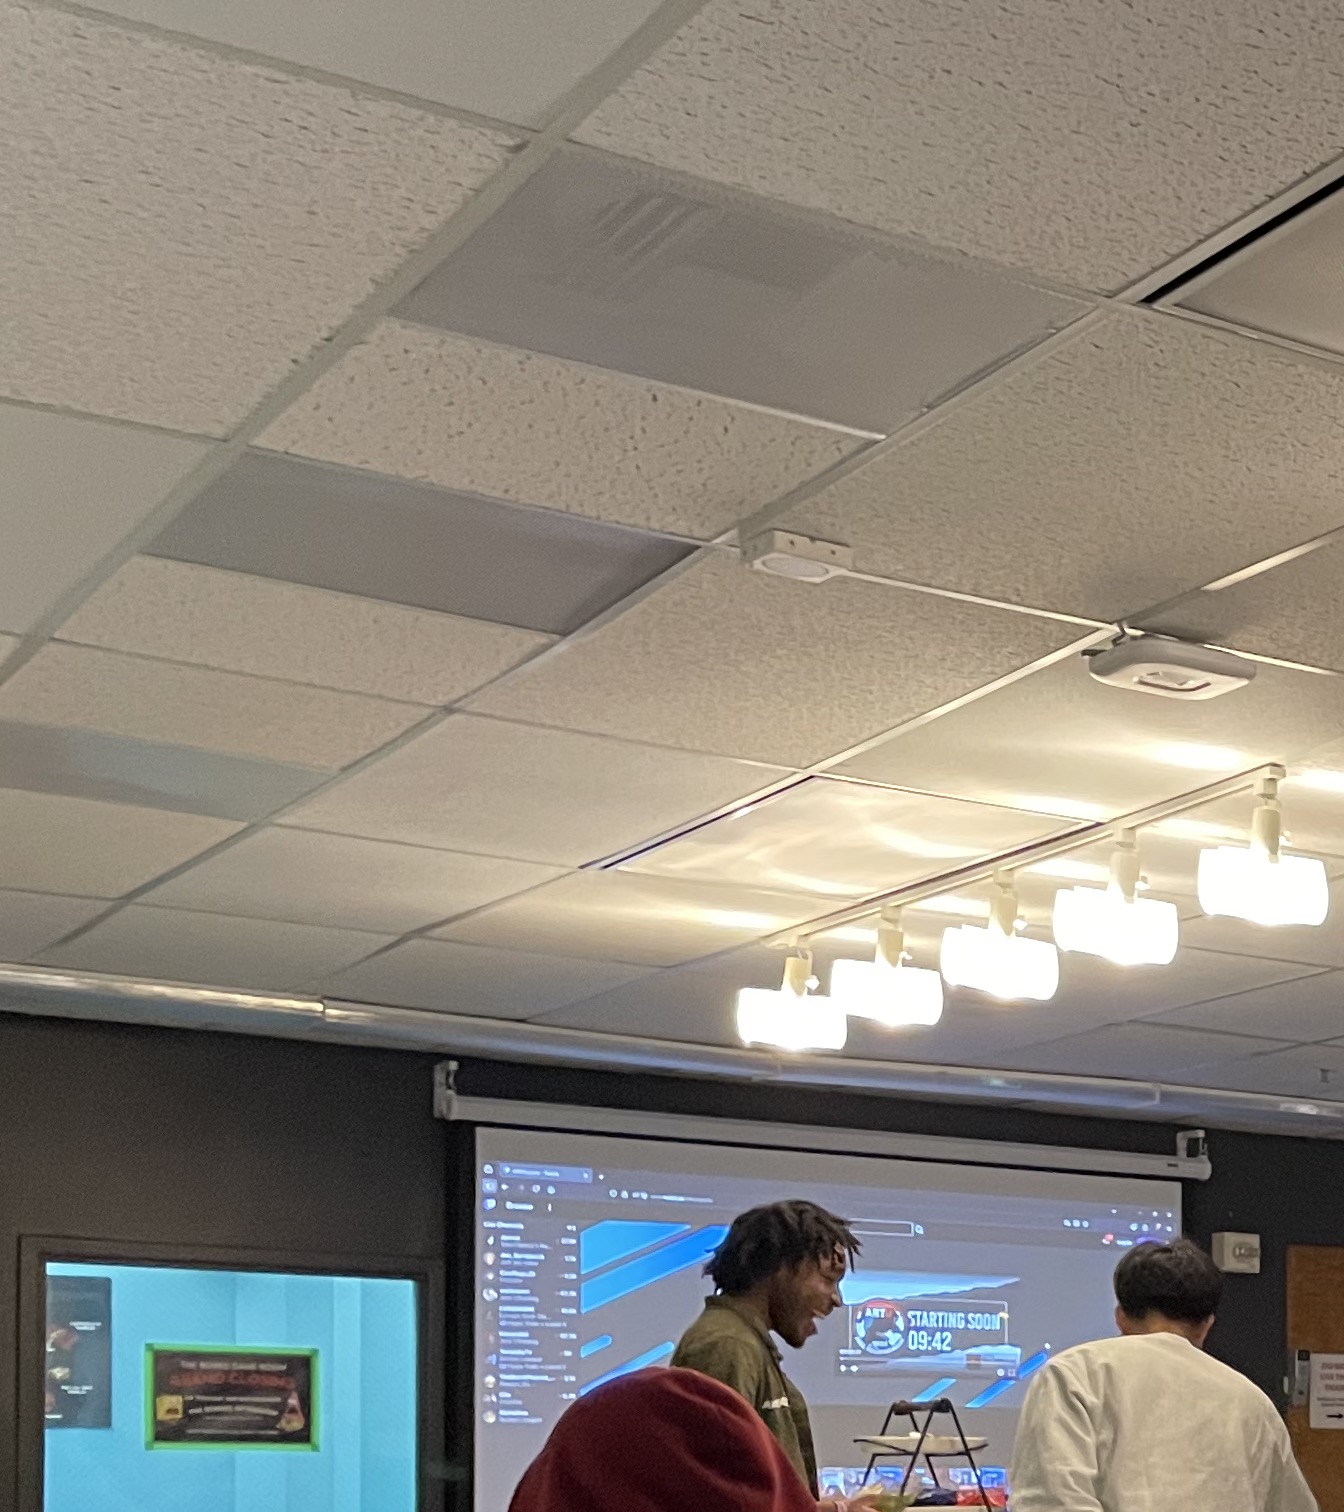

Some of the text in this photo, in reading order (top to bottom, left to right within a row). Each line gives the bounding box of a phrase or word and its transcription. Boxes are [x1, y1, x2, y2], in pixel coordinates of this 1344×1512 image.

[907, 1310, 1001, 1331] STARTING SOON
[908, 1330, 952, 1351] 09:42
